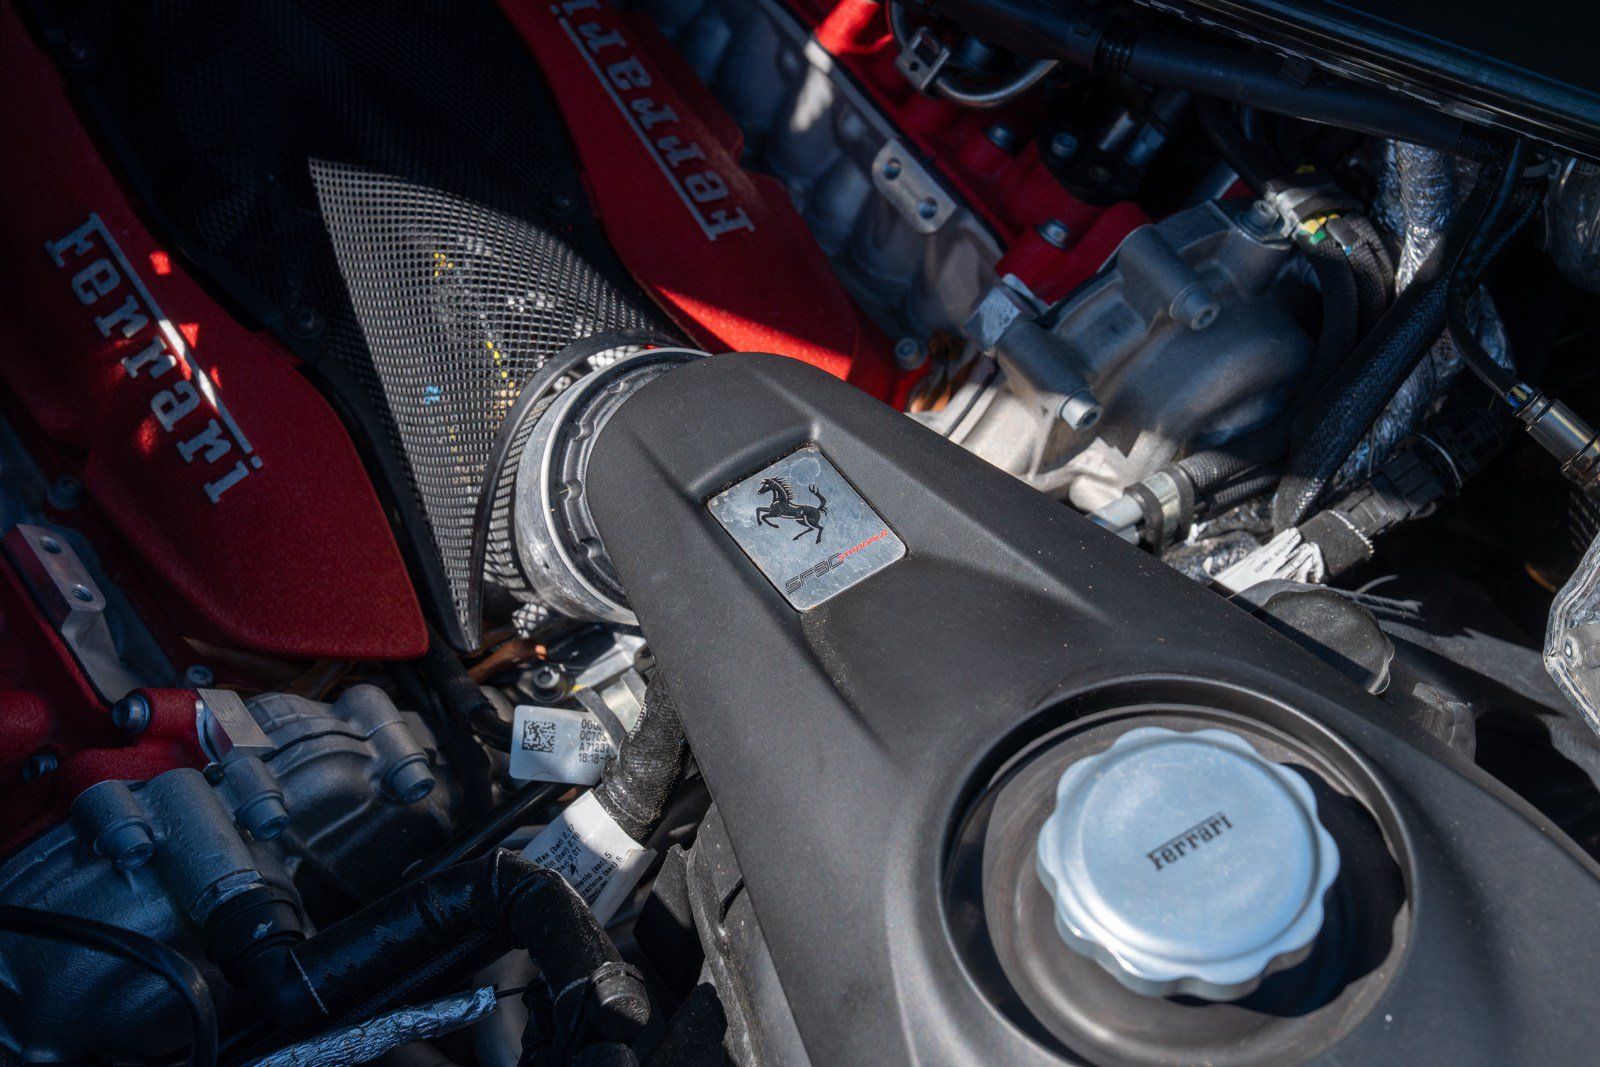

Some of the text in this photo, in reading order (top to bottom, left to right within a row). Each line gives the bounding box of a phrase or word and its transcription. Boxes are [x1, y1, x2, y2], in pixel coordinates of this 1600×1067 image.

[550, 0, 756, 241] Ferrari
[45, 211, 264, 504] Ferrari
[582, 718, 603, 731] 000
[1147, 811, 1233, 870] Ferrari
[534, 852, 550, 865] Max
[549, 838, 564, 854] (bar)
[554, 848, 570, 863] (bar)
[604, 851, 612, 859] 5
[555, 860, 570, 874] bar)
